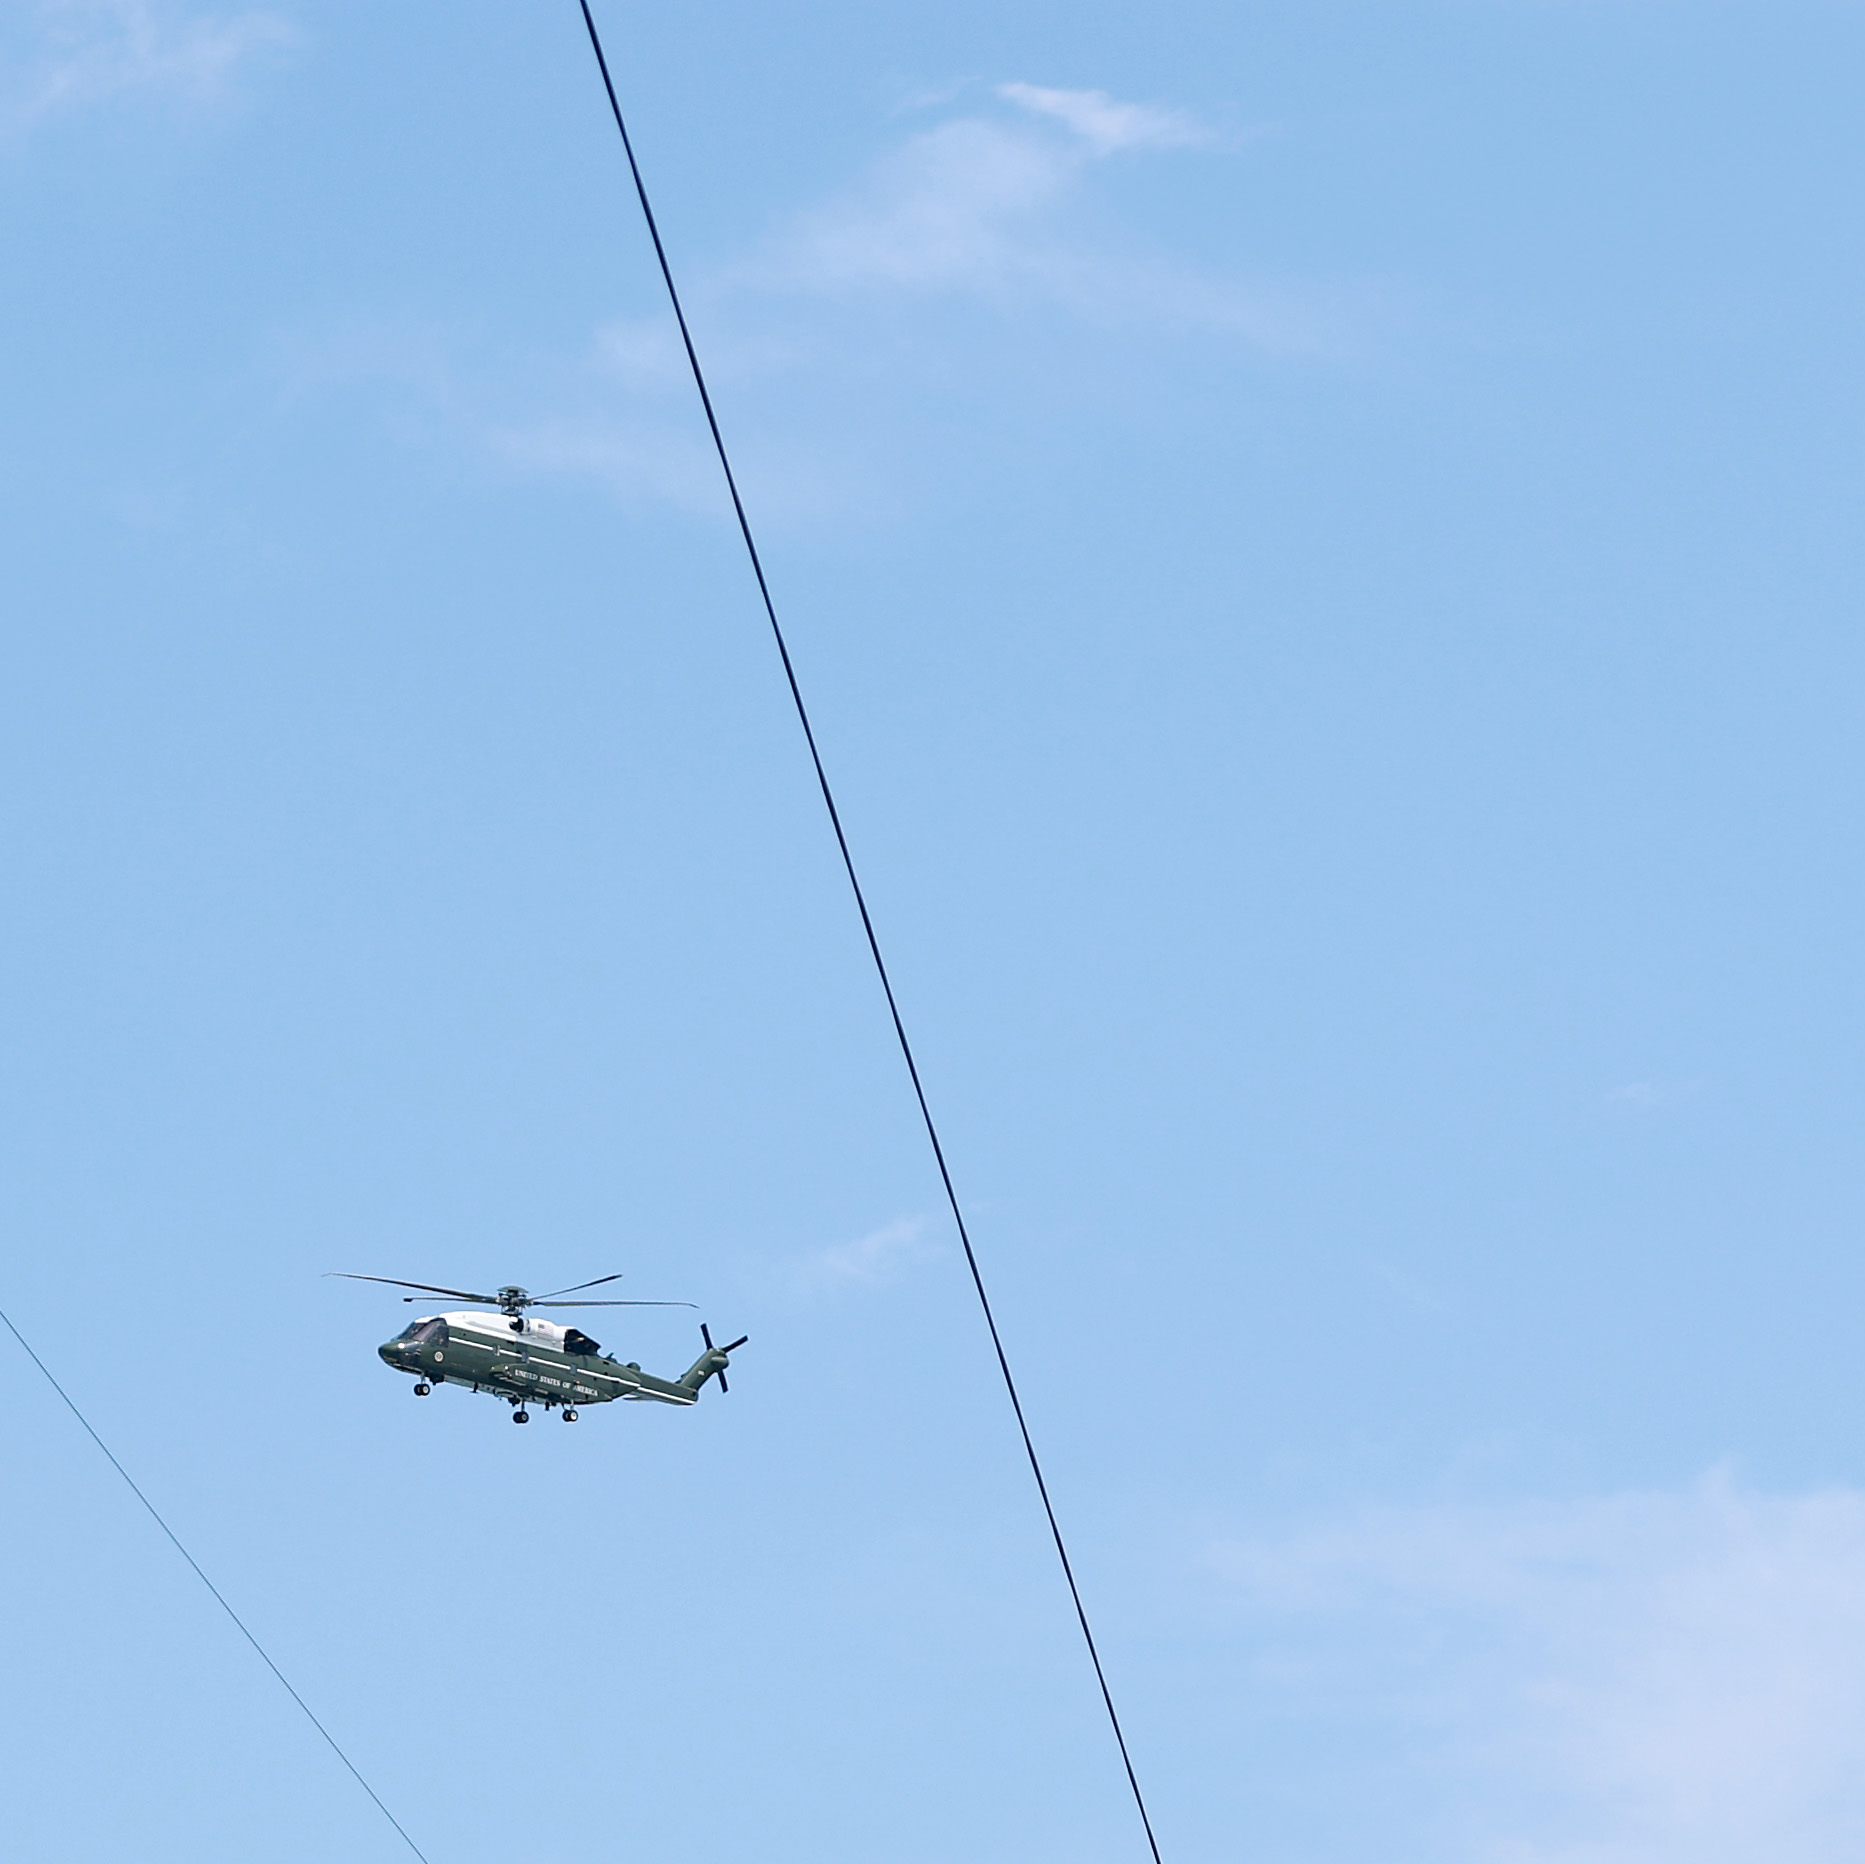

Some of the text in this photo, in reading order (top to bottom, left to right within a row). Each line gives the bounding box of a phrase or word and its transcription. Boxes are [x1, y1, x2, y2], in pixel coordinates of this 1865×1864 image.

[515, 1369, 538, 1380] UNITED
[539, 1375, 561, 1387] STATES
[562, 1381, 571, 1389] OF
